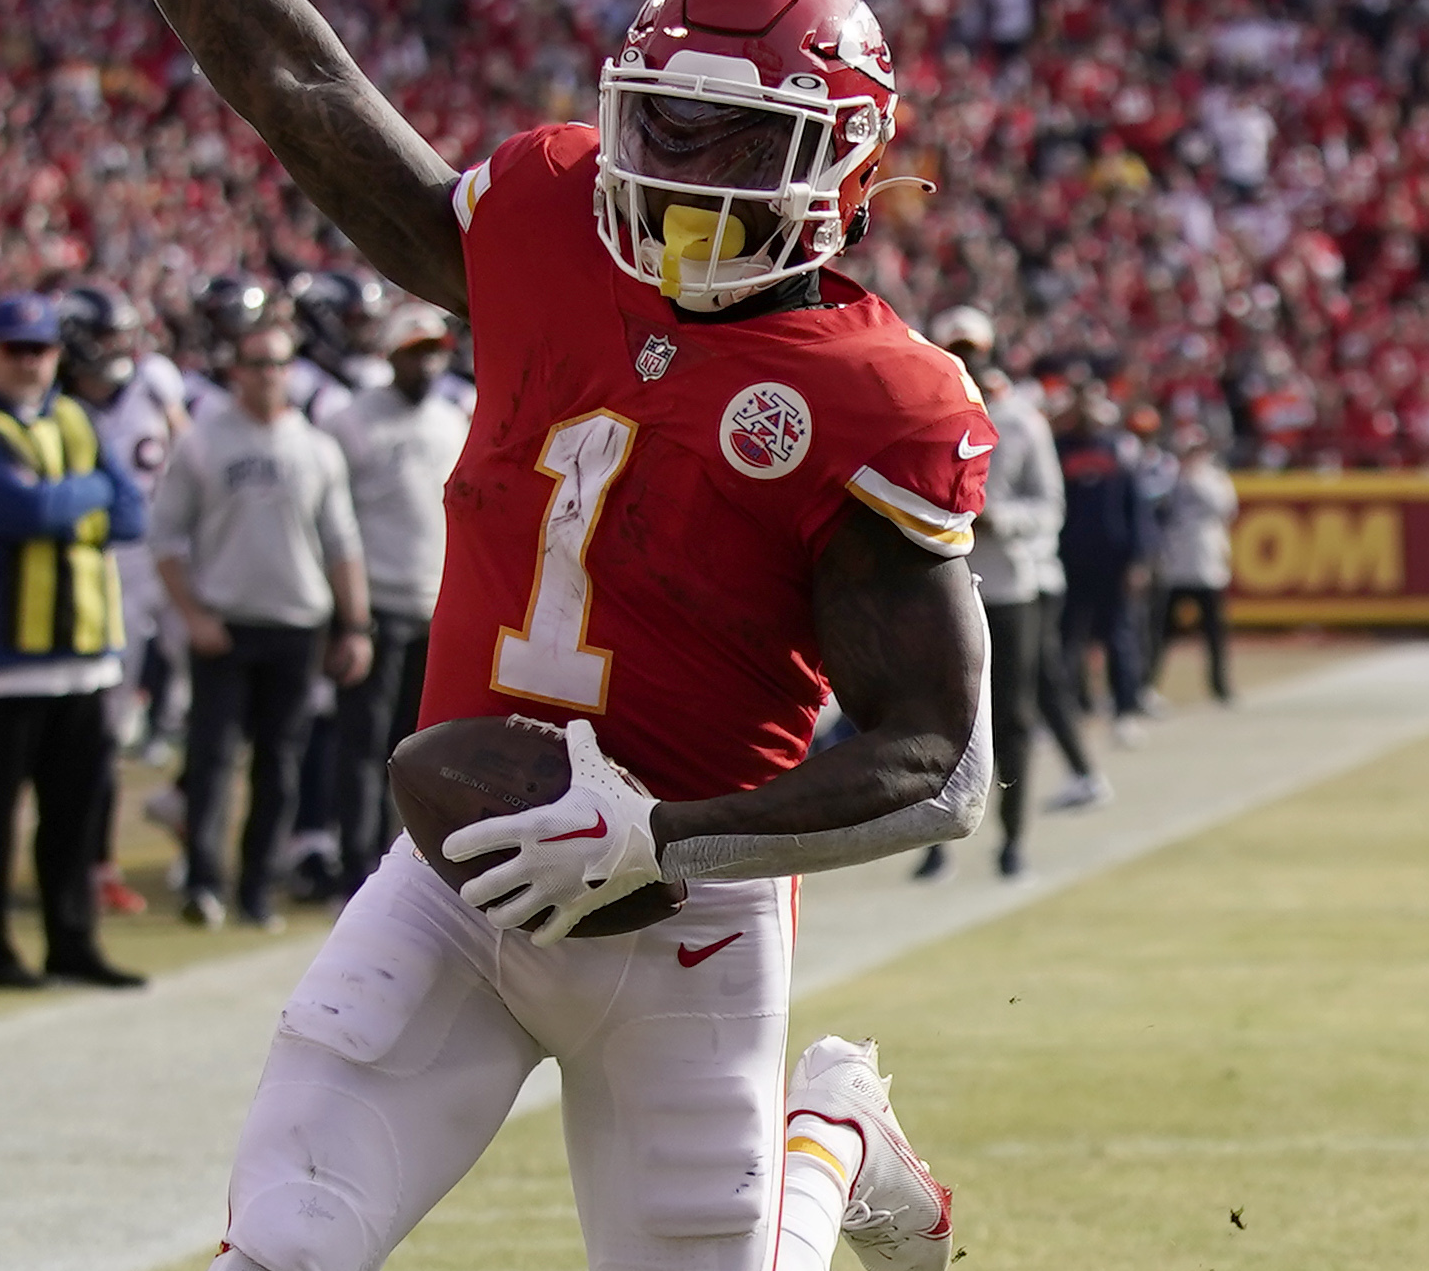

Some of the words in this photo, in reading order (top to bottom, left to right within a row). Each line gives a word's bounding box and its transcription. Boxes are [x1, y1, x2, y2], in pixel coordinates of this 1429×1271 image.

[639, 351, 663, 374] NFL
[489, 406, 639, 716] 1
[438, 765, 492, 794] NATIONAL
